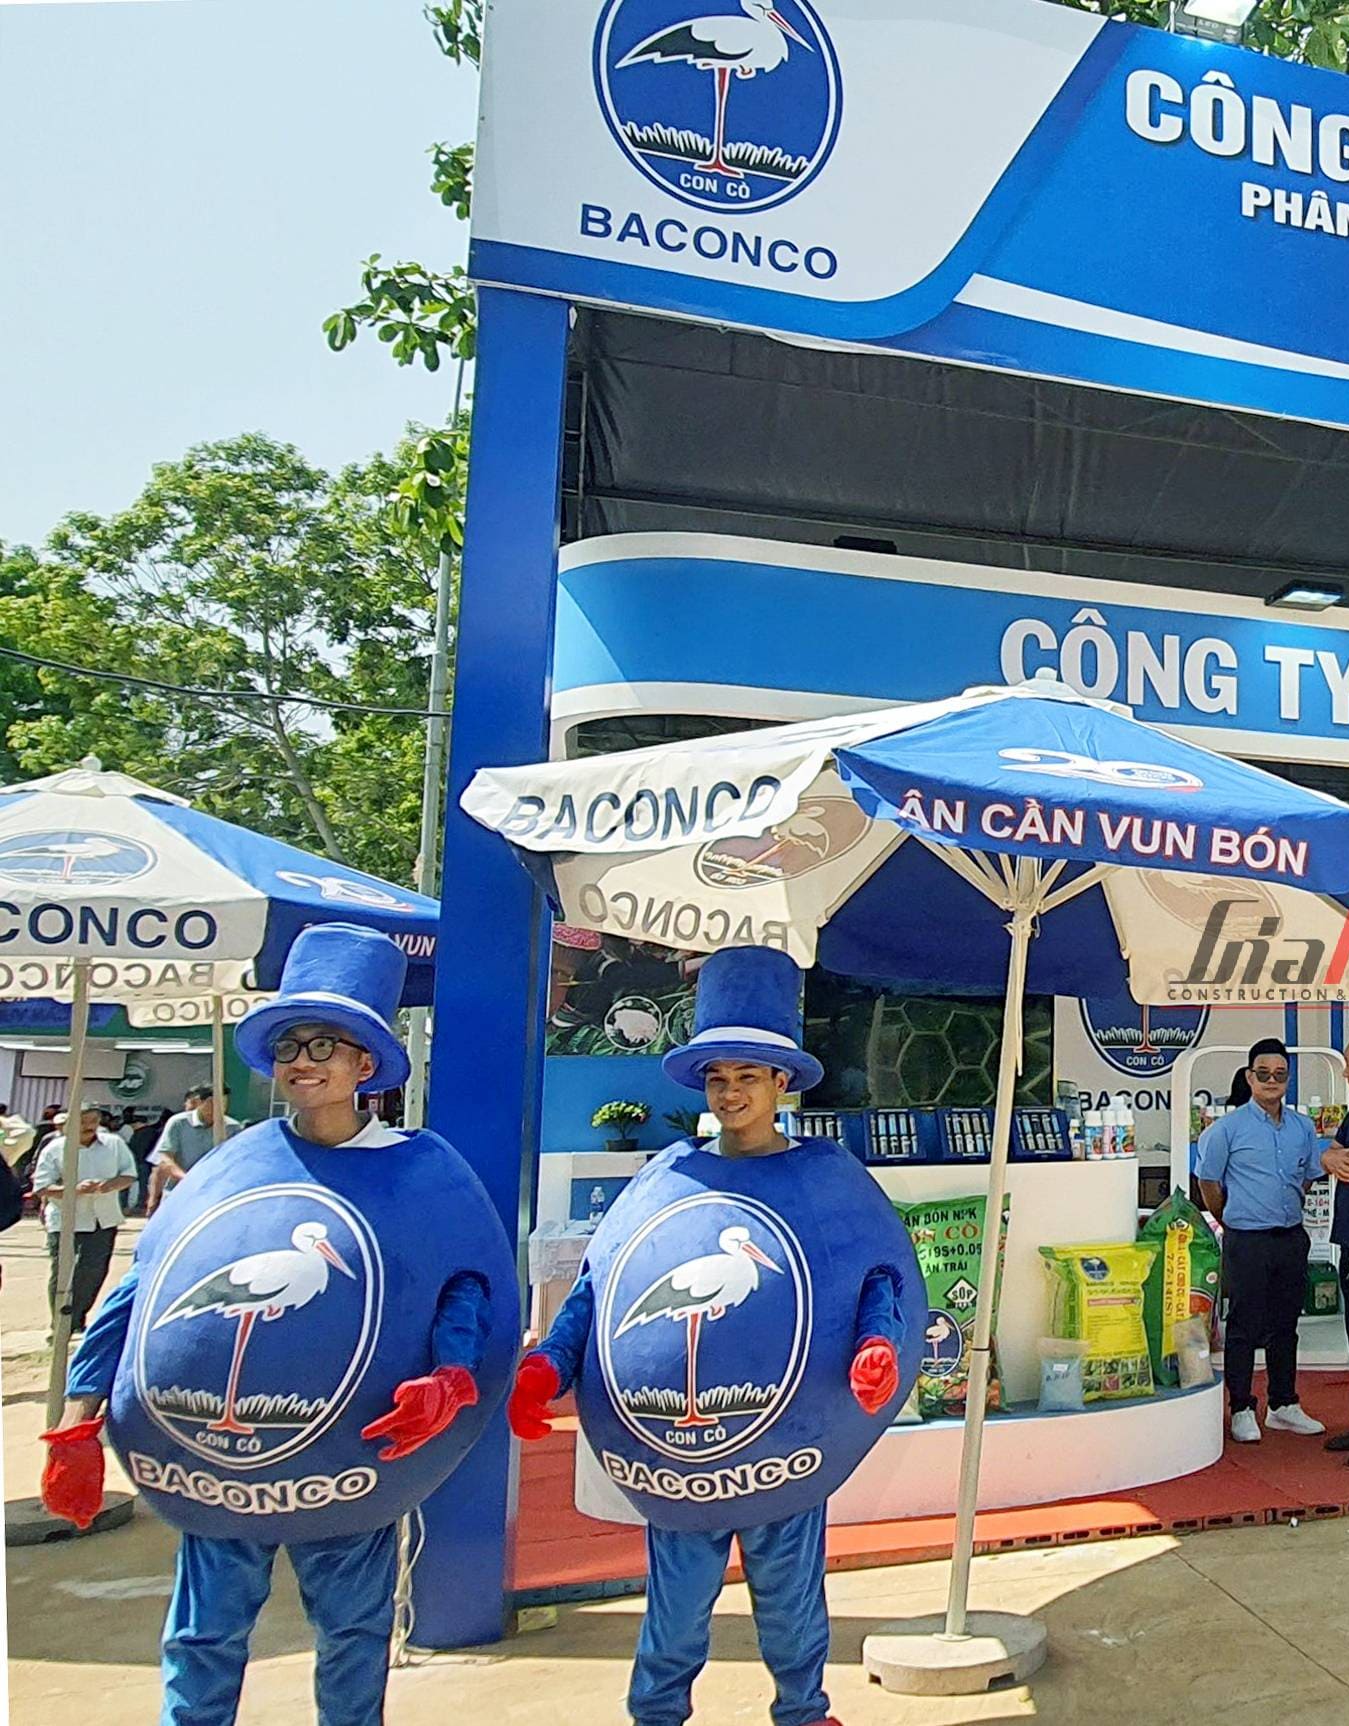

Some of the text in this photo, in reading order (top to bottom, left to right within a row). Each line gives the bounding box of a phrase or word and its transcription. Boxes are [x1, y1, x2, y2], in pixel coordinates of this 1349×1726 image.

[680, 173, 751, 199] CON CÒ
[579, 203, 839, 280] BACONCO
[1000, 607, 1239, 716] CÔNG
[902, 789, 965, 834] ÂN
[1098, 811, 1196, 860] VUN
[1209, 826, 1309, 877] BÓN
[1126, 1055, 1147, 1066] CON
[196, 1431, 229, 1450] CON
[665, 1423, 727, 1445] CON CÒ
[128, 1451, 379, 1515] BACONCO
[602, 1447, 823, 1502] BACONCO
